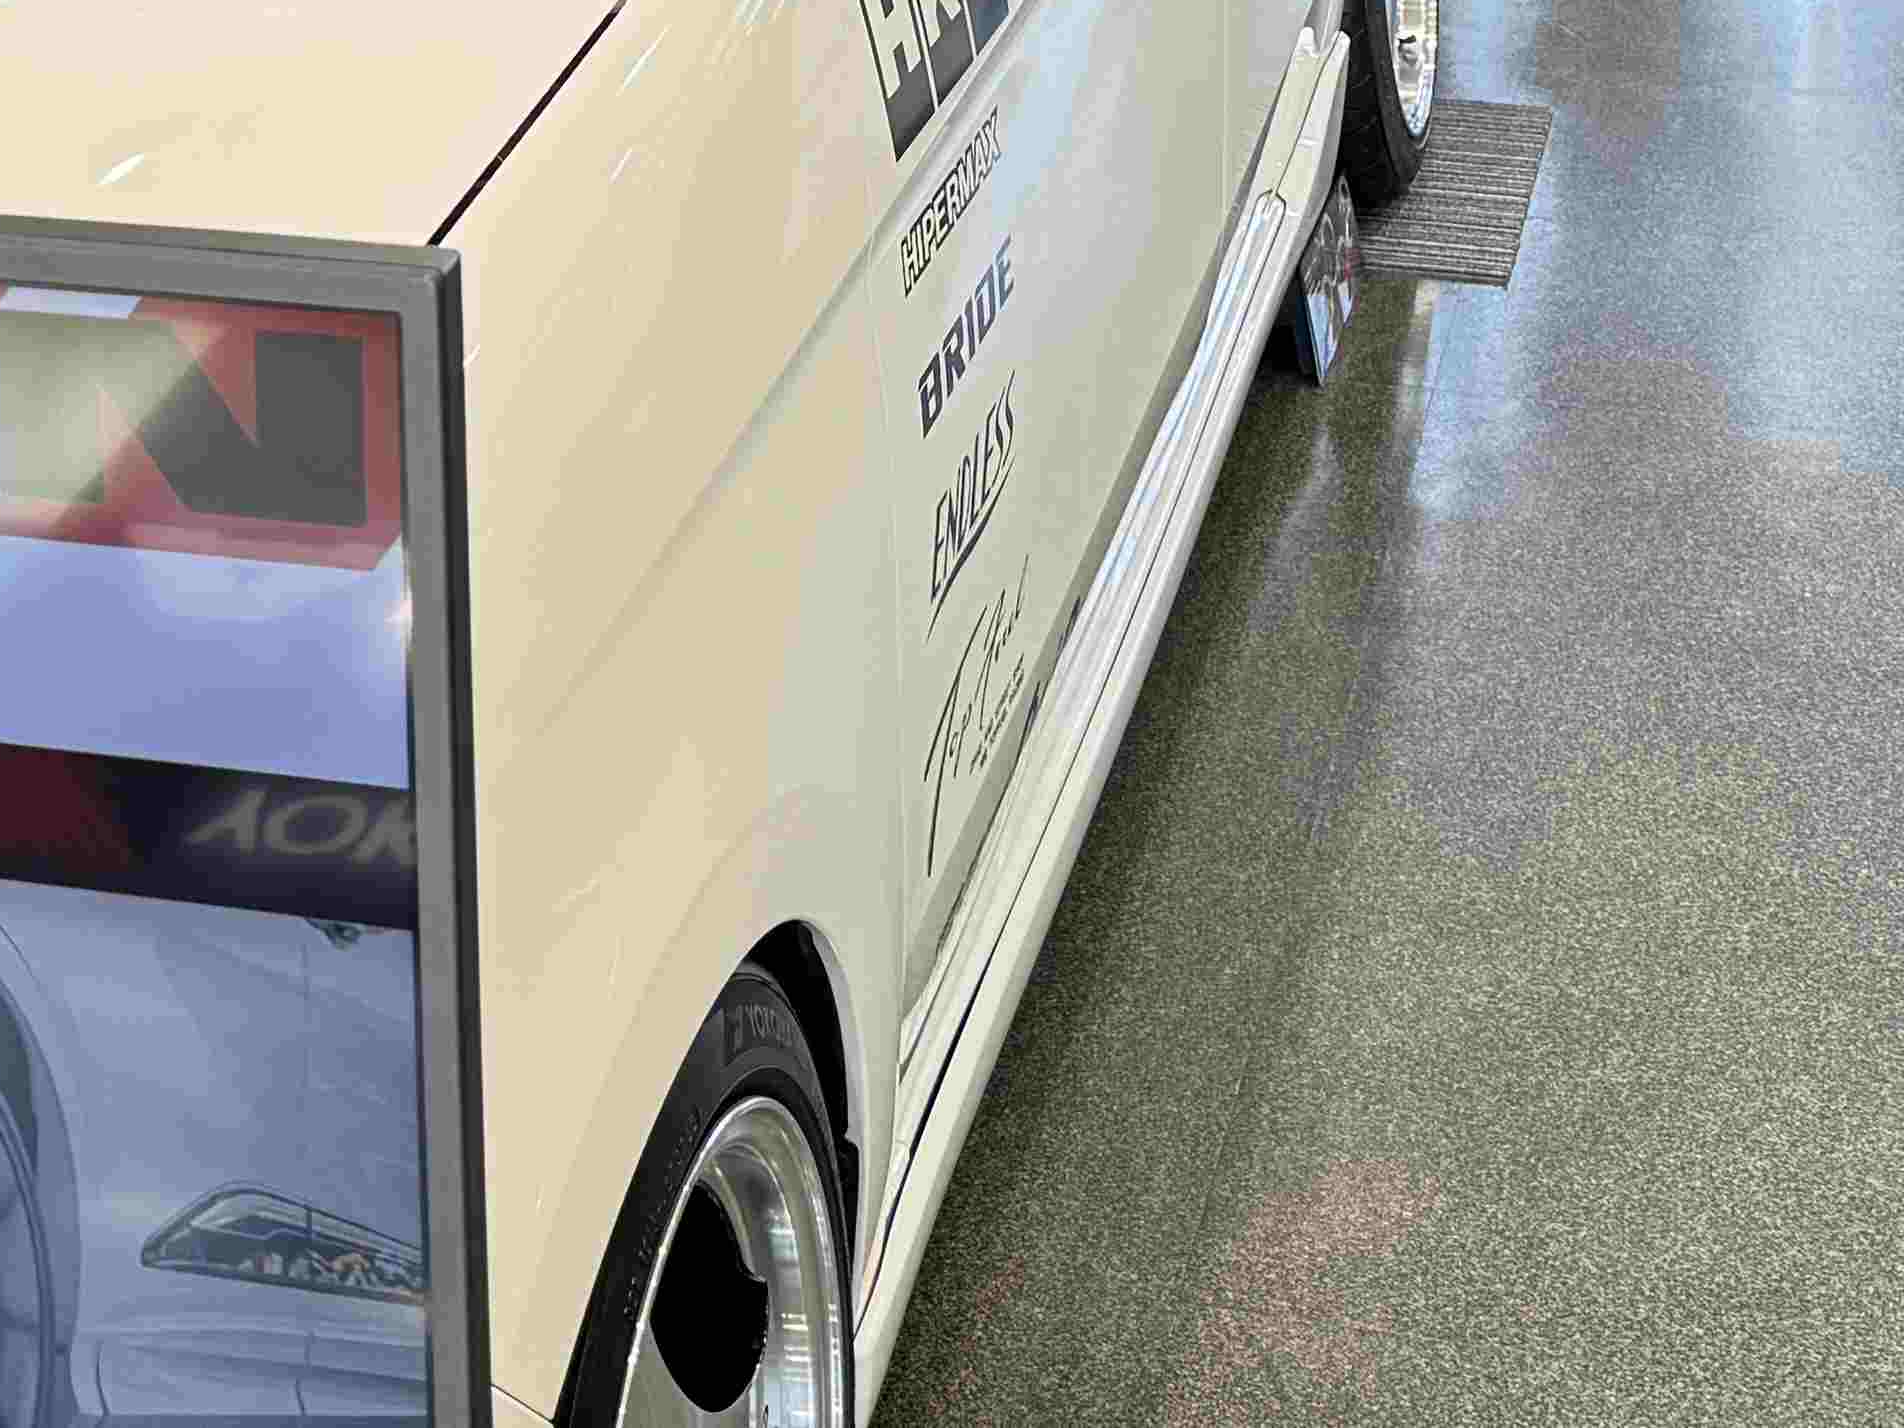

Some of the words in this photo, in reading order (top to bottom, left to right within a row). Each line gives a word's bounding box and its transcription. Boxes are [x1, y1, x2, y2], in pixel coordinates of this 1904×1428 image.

[899, 105, 1003, 300] HIPERMAX
[917, 232, 1016, 441] BRIDE
[930, 369, 1017, 606] ENDLESS
